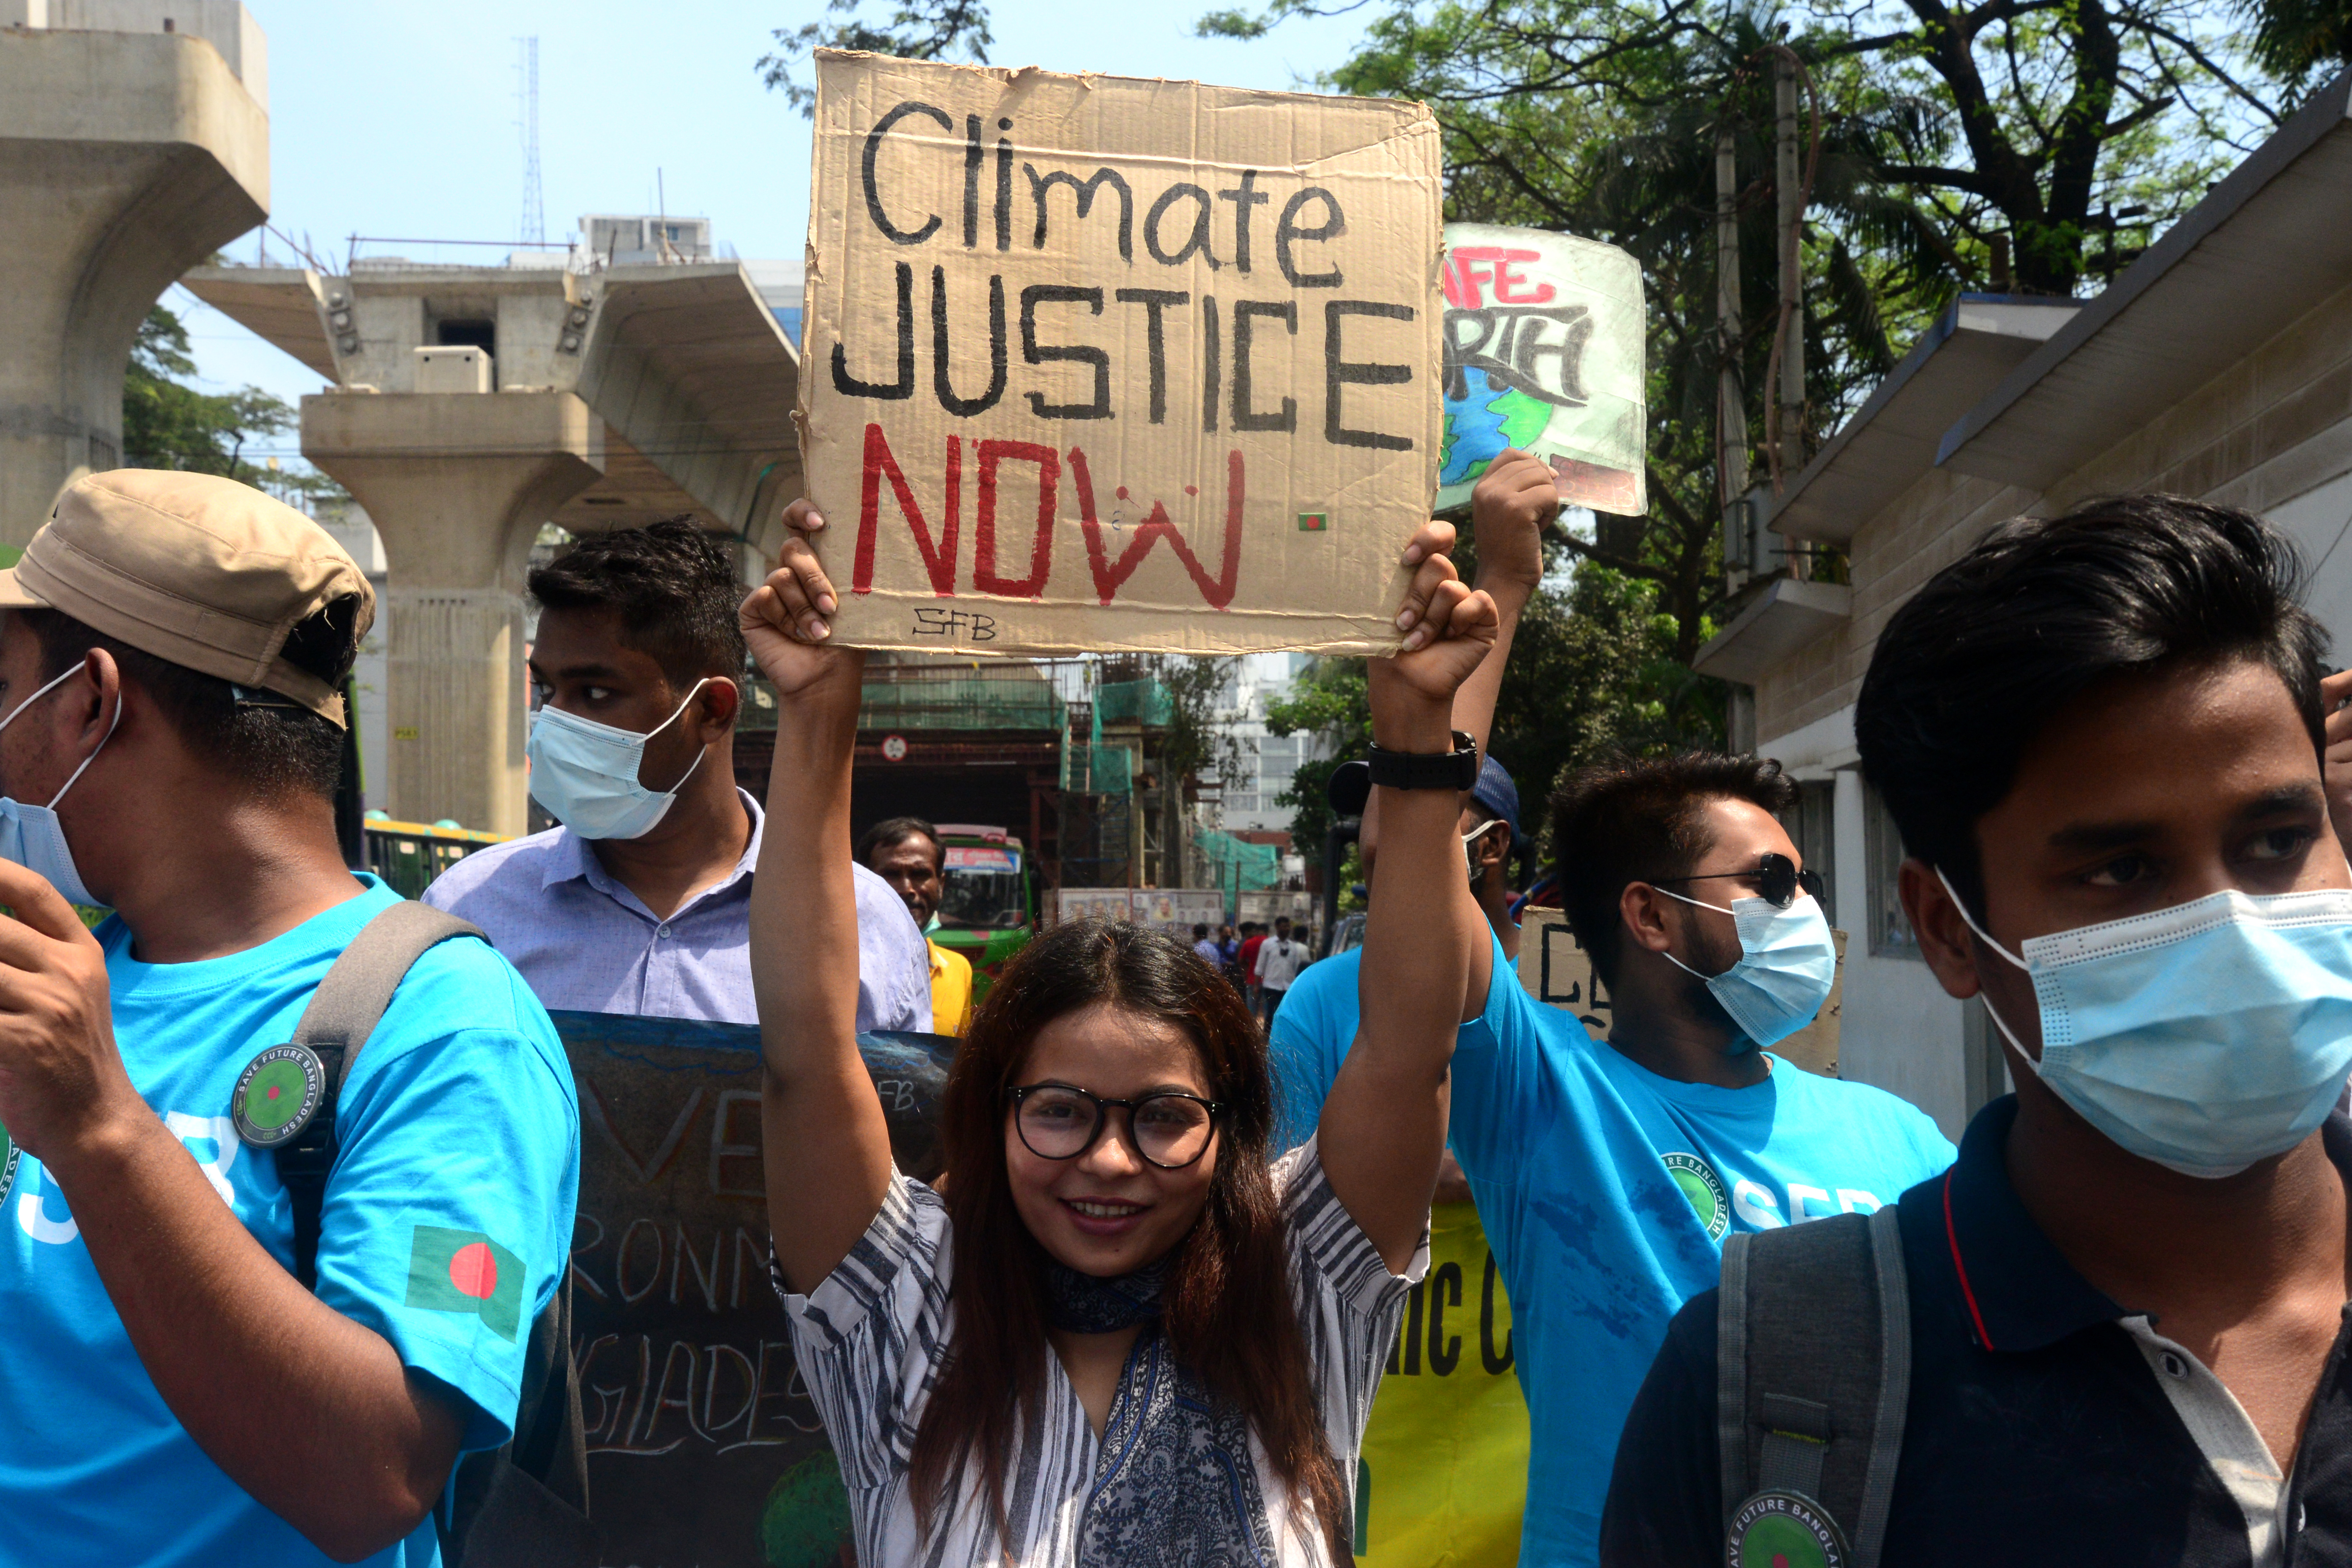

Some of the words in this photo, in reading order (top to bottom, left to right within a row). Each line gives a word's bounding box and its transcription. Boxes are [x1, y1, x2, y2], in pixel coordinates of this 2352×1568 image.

[861, 100, 1346, 288] Climate
[830, 260, 1416, 452] JUSTICE
[1441, 303, 1595, 408] RTH
[851, 422, 1246, 612] NOW
[912, 608, 996, 641] SFB
[239, 1063, 260, 1092] SAVE
[262, 1049, 303, 1063] FUTURE
[282, 1060, 316, 1135] BANGLADESH
[1688, 1158, 1726, 1235] BANGLADESH
[1736, 1499, 1785, 1531] FUTURE
[1792, 1504, 1839, 1568] BANGLA
